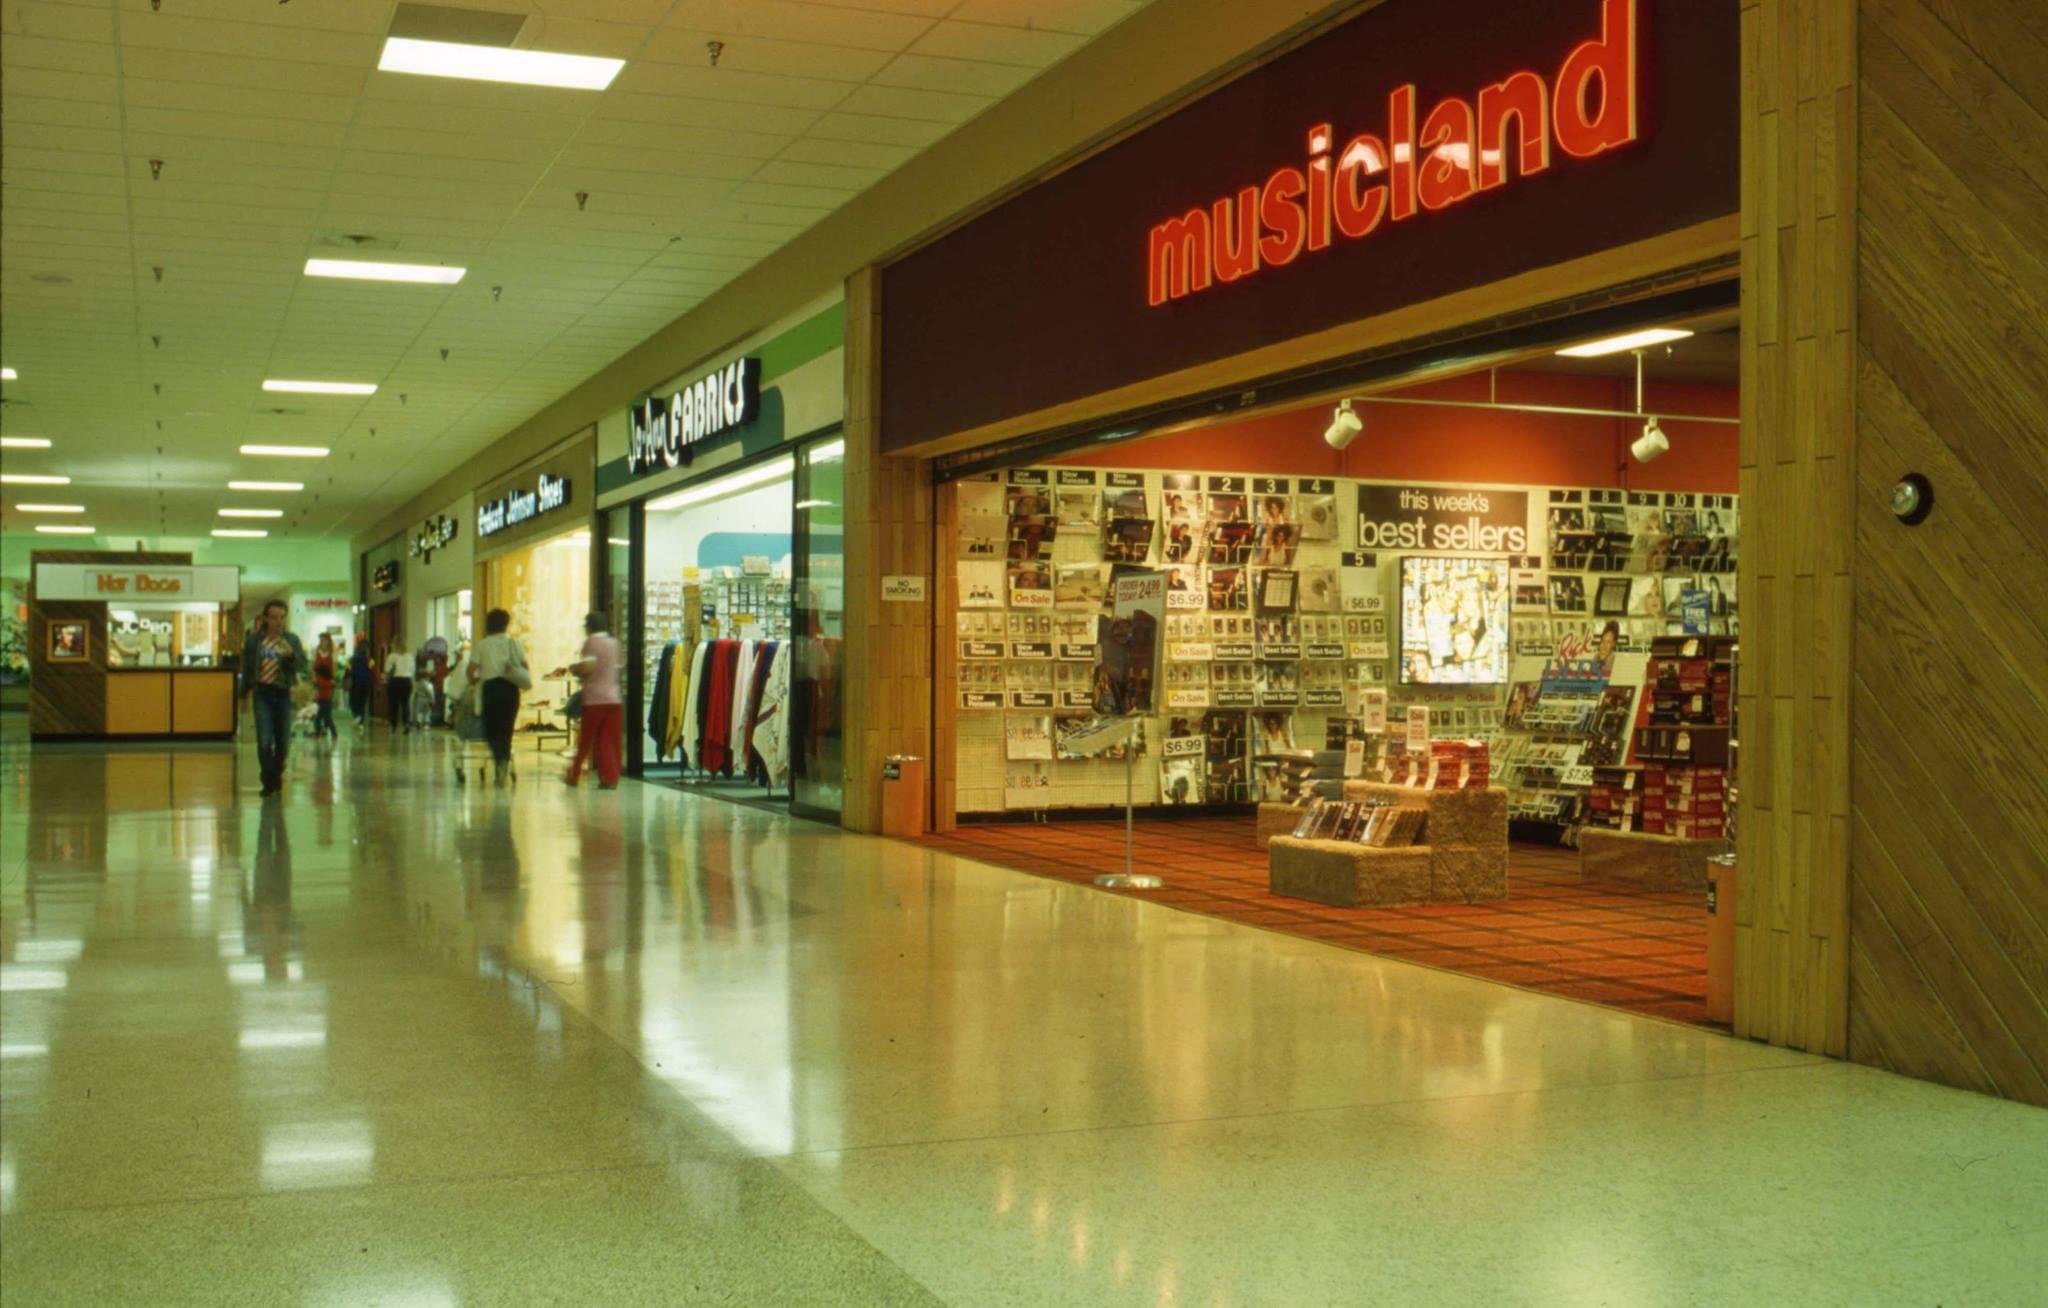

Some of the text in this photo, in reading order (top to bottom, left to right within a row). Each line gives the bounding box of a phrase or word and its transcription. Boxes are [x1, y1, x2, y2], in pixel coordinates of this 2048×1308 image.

[1148, 0, 1638, 306] musicland
[628, 357, 746, 474] Jo-Ann FABRICS
[1222, 477, 1231, 492] 2
[1267, 479, 1276, 493] 3
[1311, 480, 1321, 492] 4
[538, 473, 563, 513] Shoes
[1561, 490, 1569, 503] 7
[1602, 491, 1609, 503] 8
[1640, 493, 1647, 505] 9
[1400, 490, 1489, 512] this week's
[1674, 494, 1686, 506] 10
[1712, 495, 1722, 508] 11
[1359, 513, 1525, 551] best sellers
[1355, 554, 1364, 567] 5
[1520, 556, 1529, 568] 6
[1015, 591, 1050, 604] On Sale
[1168, 594, 1204, 606] $6.99
[1351, 597, 1380, 609] $6.99
[1354, 646, 1385, 655] On Sale
[1559, 628, 1593, 660] Rick
[1175, 648, 1208, 657] On Sale
[1172, 693, 1206, 703] On Sale
[1424, 694, 1438, 702] On
[1467, 694, 1479, 702] On
[1166, 739, 1202, 754] $6.99
